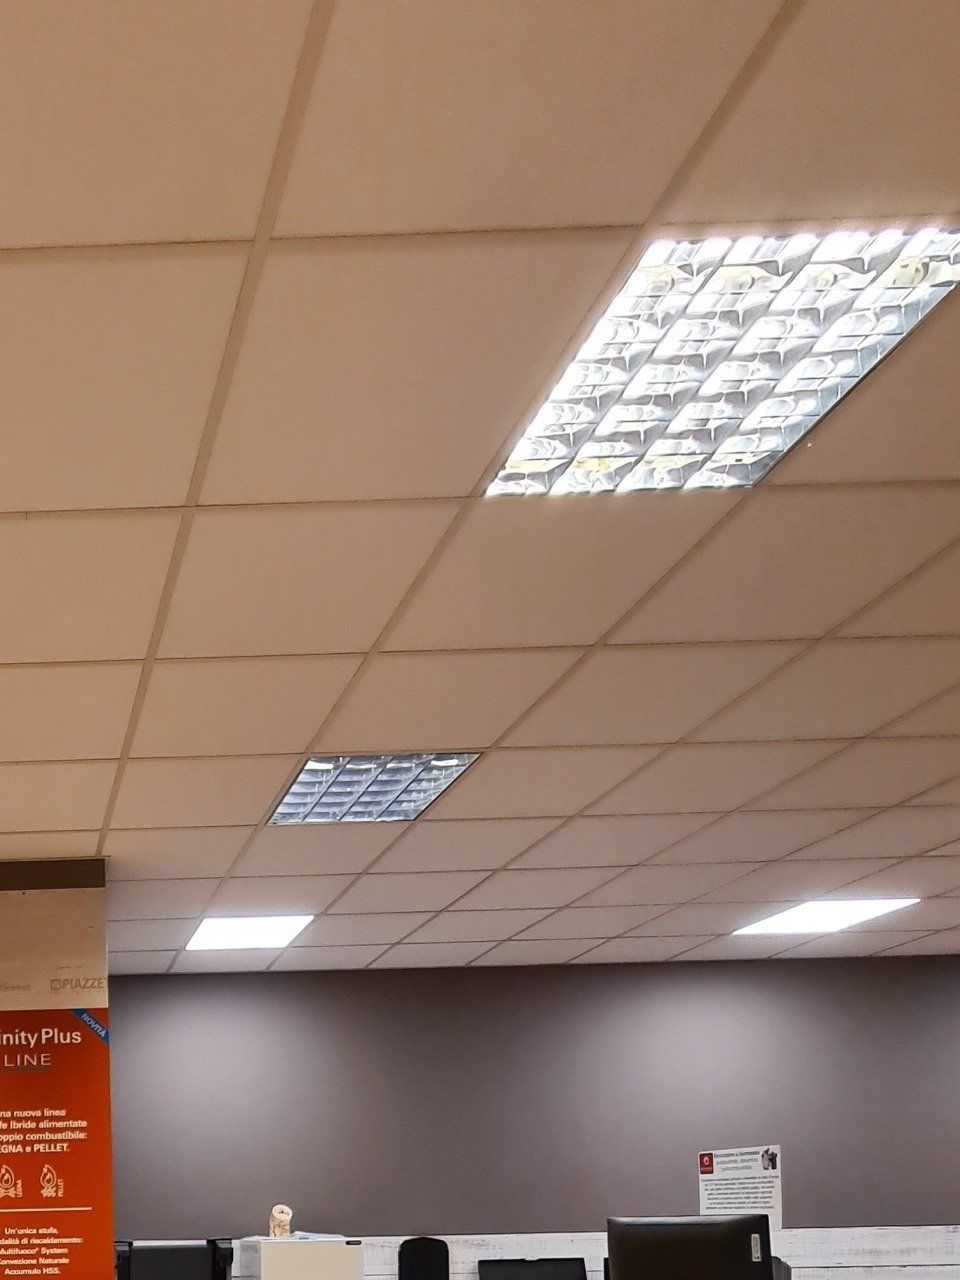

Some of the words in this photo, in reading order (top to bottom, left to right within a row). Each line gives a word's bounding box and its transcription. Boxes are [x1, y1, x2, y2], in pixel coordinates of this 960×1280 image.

[41, 1027, 82, 1045] Plus
[4, 1053, 53, 1067] LINE
[14, 1110, 41, 1118] nuova
[43, 1108, 66, 1117] linea
[10, 1120, 36, 1129] Ibride
[38, 1120, 87, 1129] alimentate
[25, 1131, 87, 1140] combustibile:
[33, 1143, 70, 1152] PELLET.
[4, 1227, 37, 1235] Un'unica
[21, 1237, 28, 1245] di
[40, 1247, 68, 1256] System
[38, 1256, 69, 1264] Naturale
[4, 1267, 41, 1275] Accumulo
